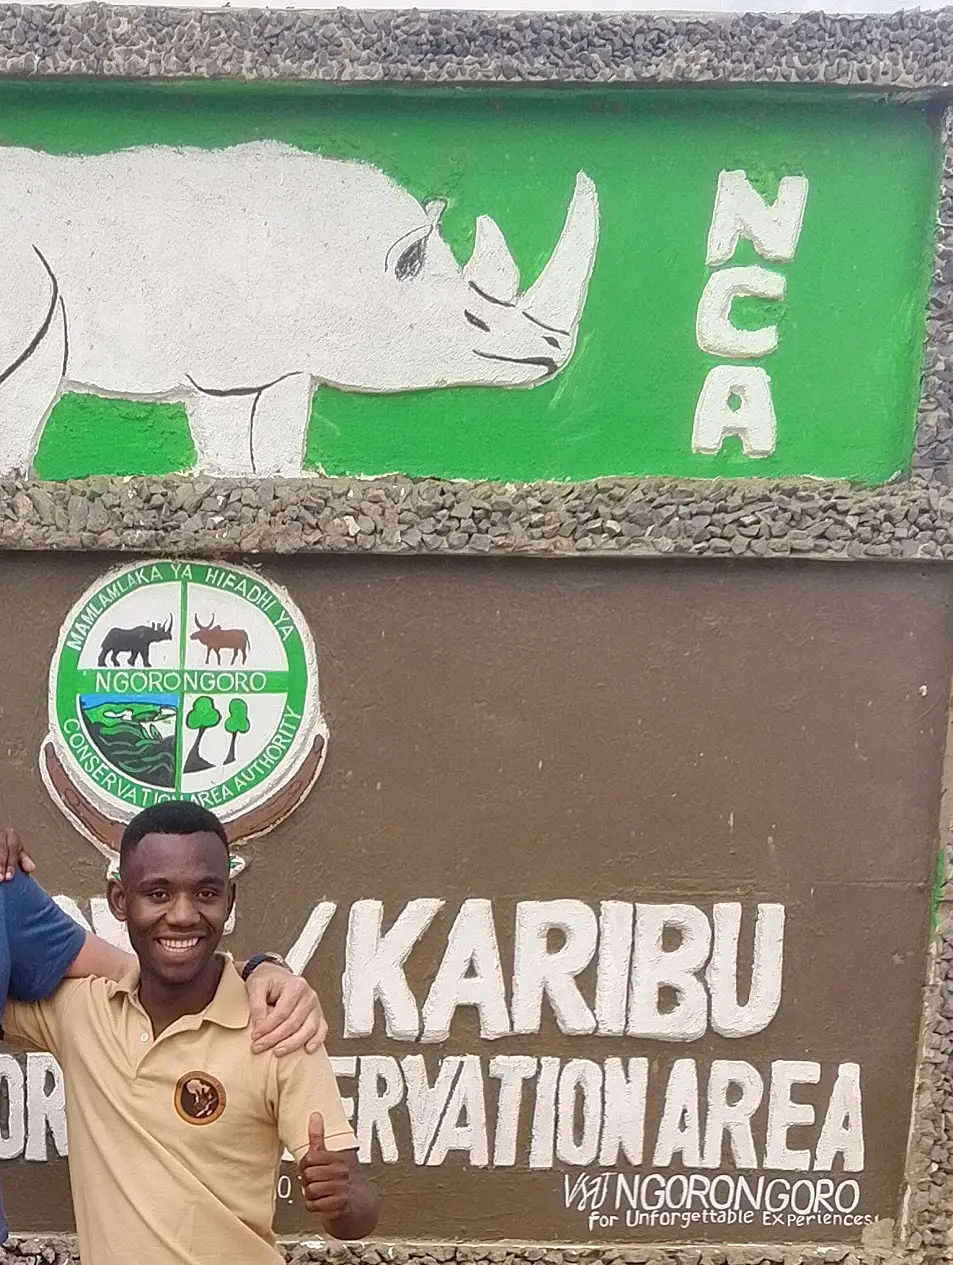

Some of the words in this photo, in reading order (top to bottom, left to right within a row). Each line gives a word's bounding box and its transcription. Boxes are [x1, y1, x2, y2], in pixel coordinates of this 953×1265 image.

[66, 565, 163, 651] MAMLAMLAKA
[170, 563, 193, 580] YA
[205, 568, 277, 612] HIFADHI
[274, 610, 294, 641] YA
[95, 671, 267, 693] NGORONGORO
[190, 784, 234, 807] AREA
[234, 705, 302, 791] AUTHORITY
[342, 898, 786, 1043] KARIBU
[652, 1059, 864, 1172] AREA
[588, 1210, 619, 1231] for
[626, 1209, 754, 1229] Unforgettable
[615, 1173, 861, 1214] NGORONGORO
